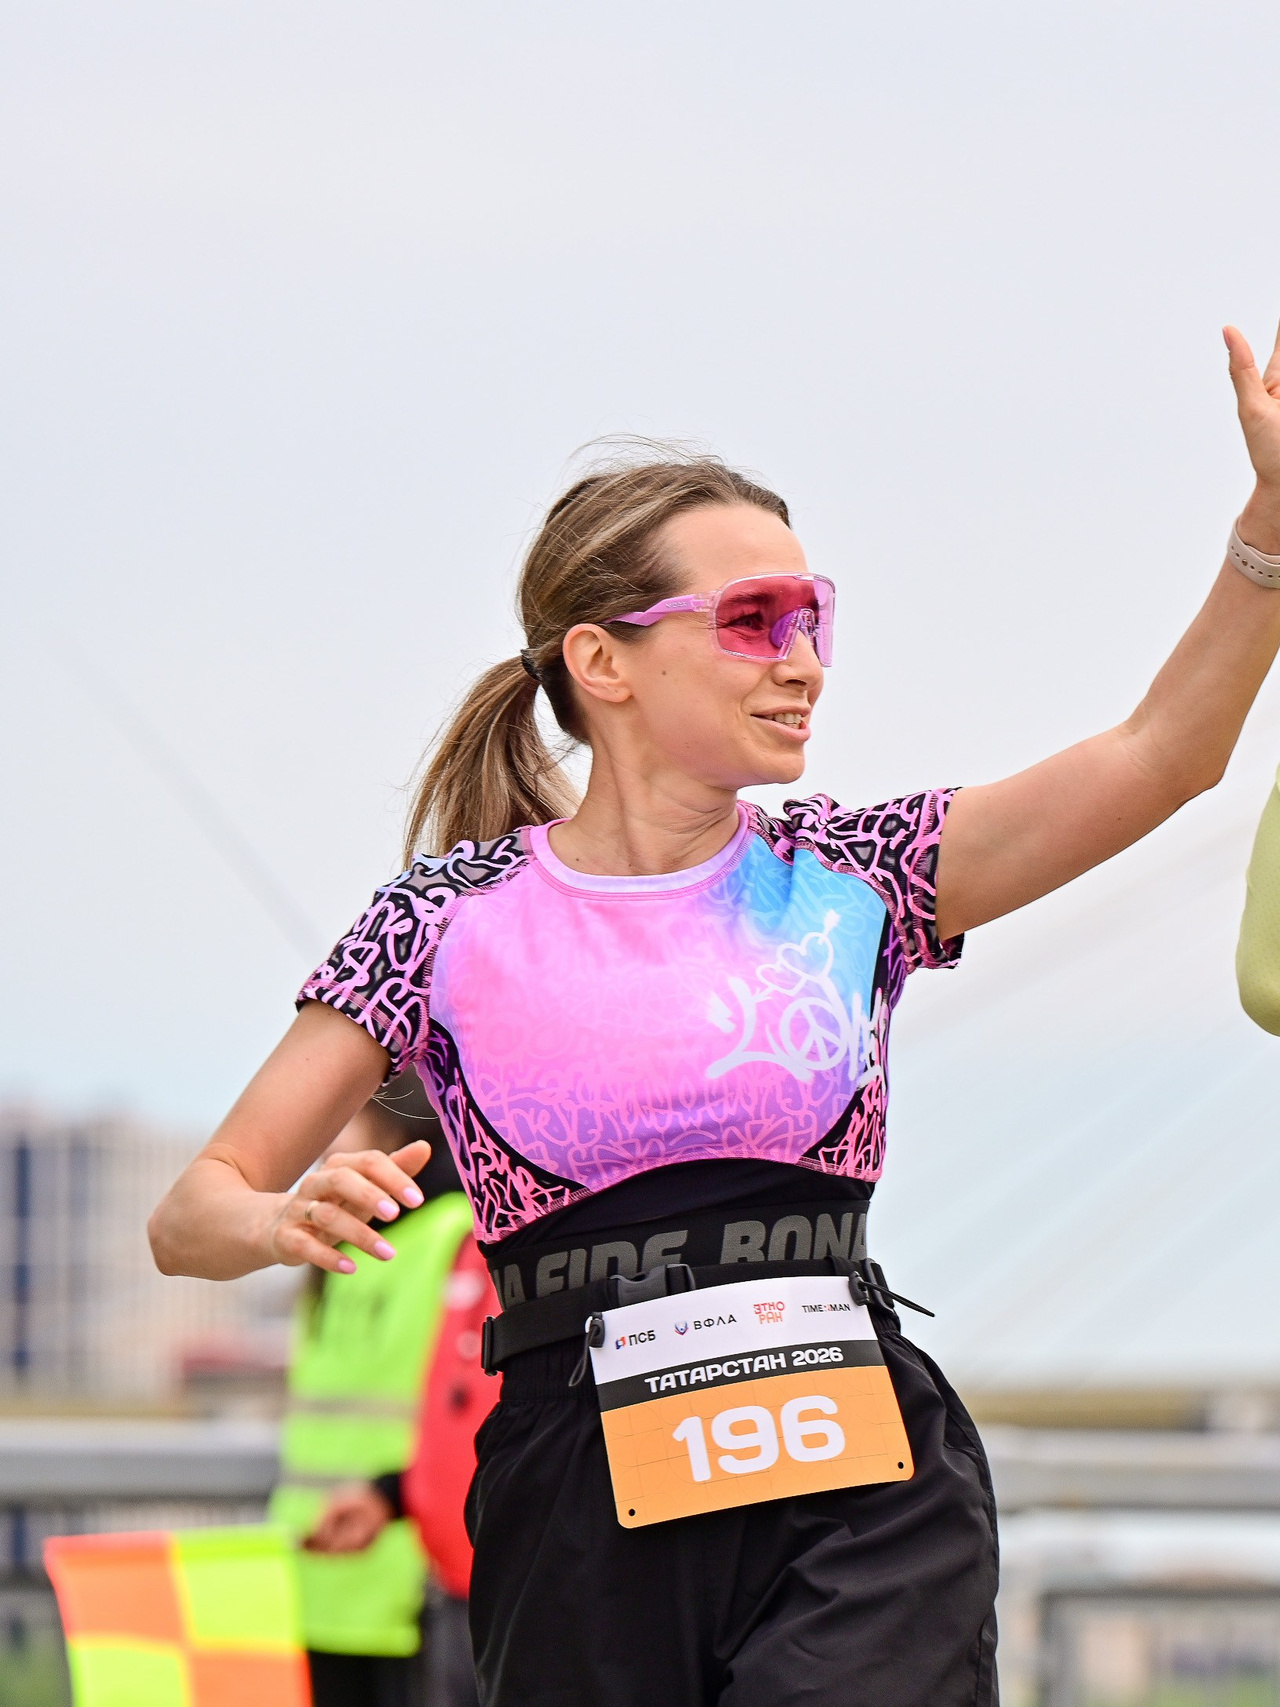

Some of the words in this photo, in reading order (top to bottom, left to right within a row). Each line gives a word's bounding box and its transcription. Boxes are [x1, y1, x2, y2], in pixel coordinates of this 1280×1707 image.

[753, 1301, 785, 1315] ЭТНО
[759, 1311, 783, 1325] РАН
[628, 1330, 656, 1346] ПСБ
[693, 1314, 737, 1330] ВФЛА
[644, 1353, 787, 1393] ТАТАРСТАН
[791, 1346, 844, 1366] 2026
[672, 1395, 845, 1482] 196
